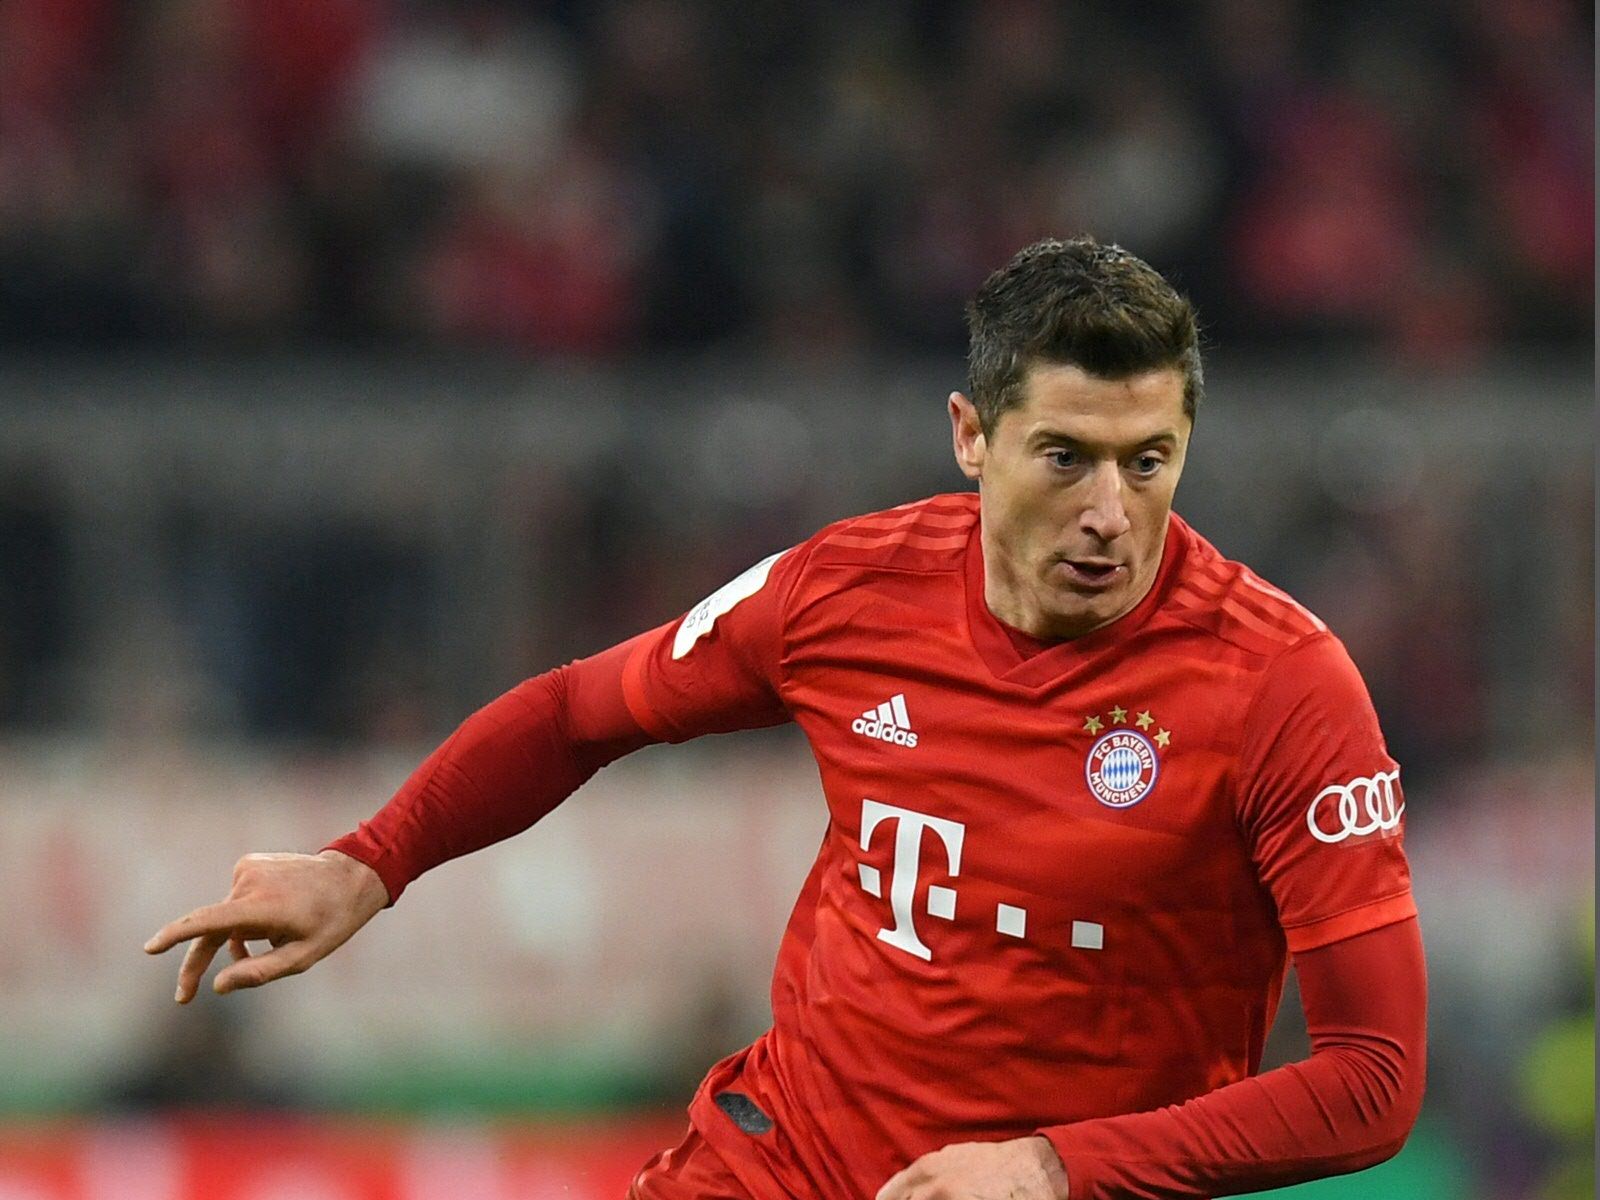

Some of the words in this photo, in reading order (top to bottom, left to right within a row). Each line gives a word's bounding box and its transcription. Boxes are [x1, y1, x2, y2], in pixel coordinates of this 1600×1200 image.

[851, 718, 919, 748] adidas
[1094, 742, 1112, 761] FC
[1112, 736, 1153, 769] BAYERN
